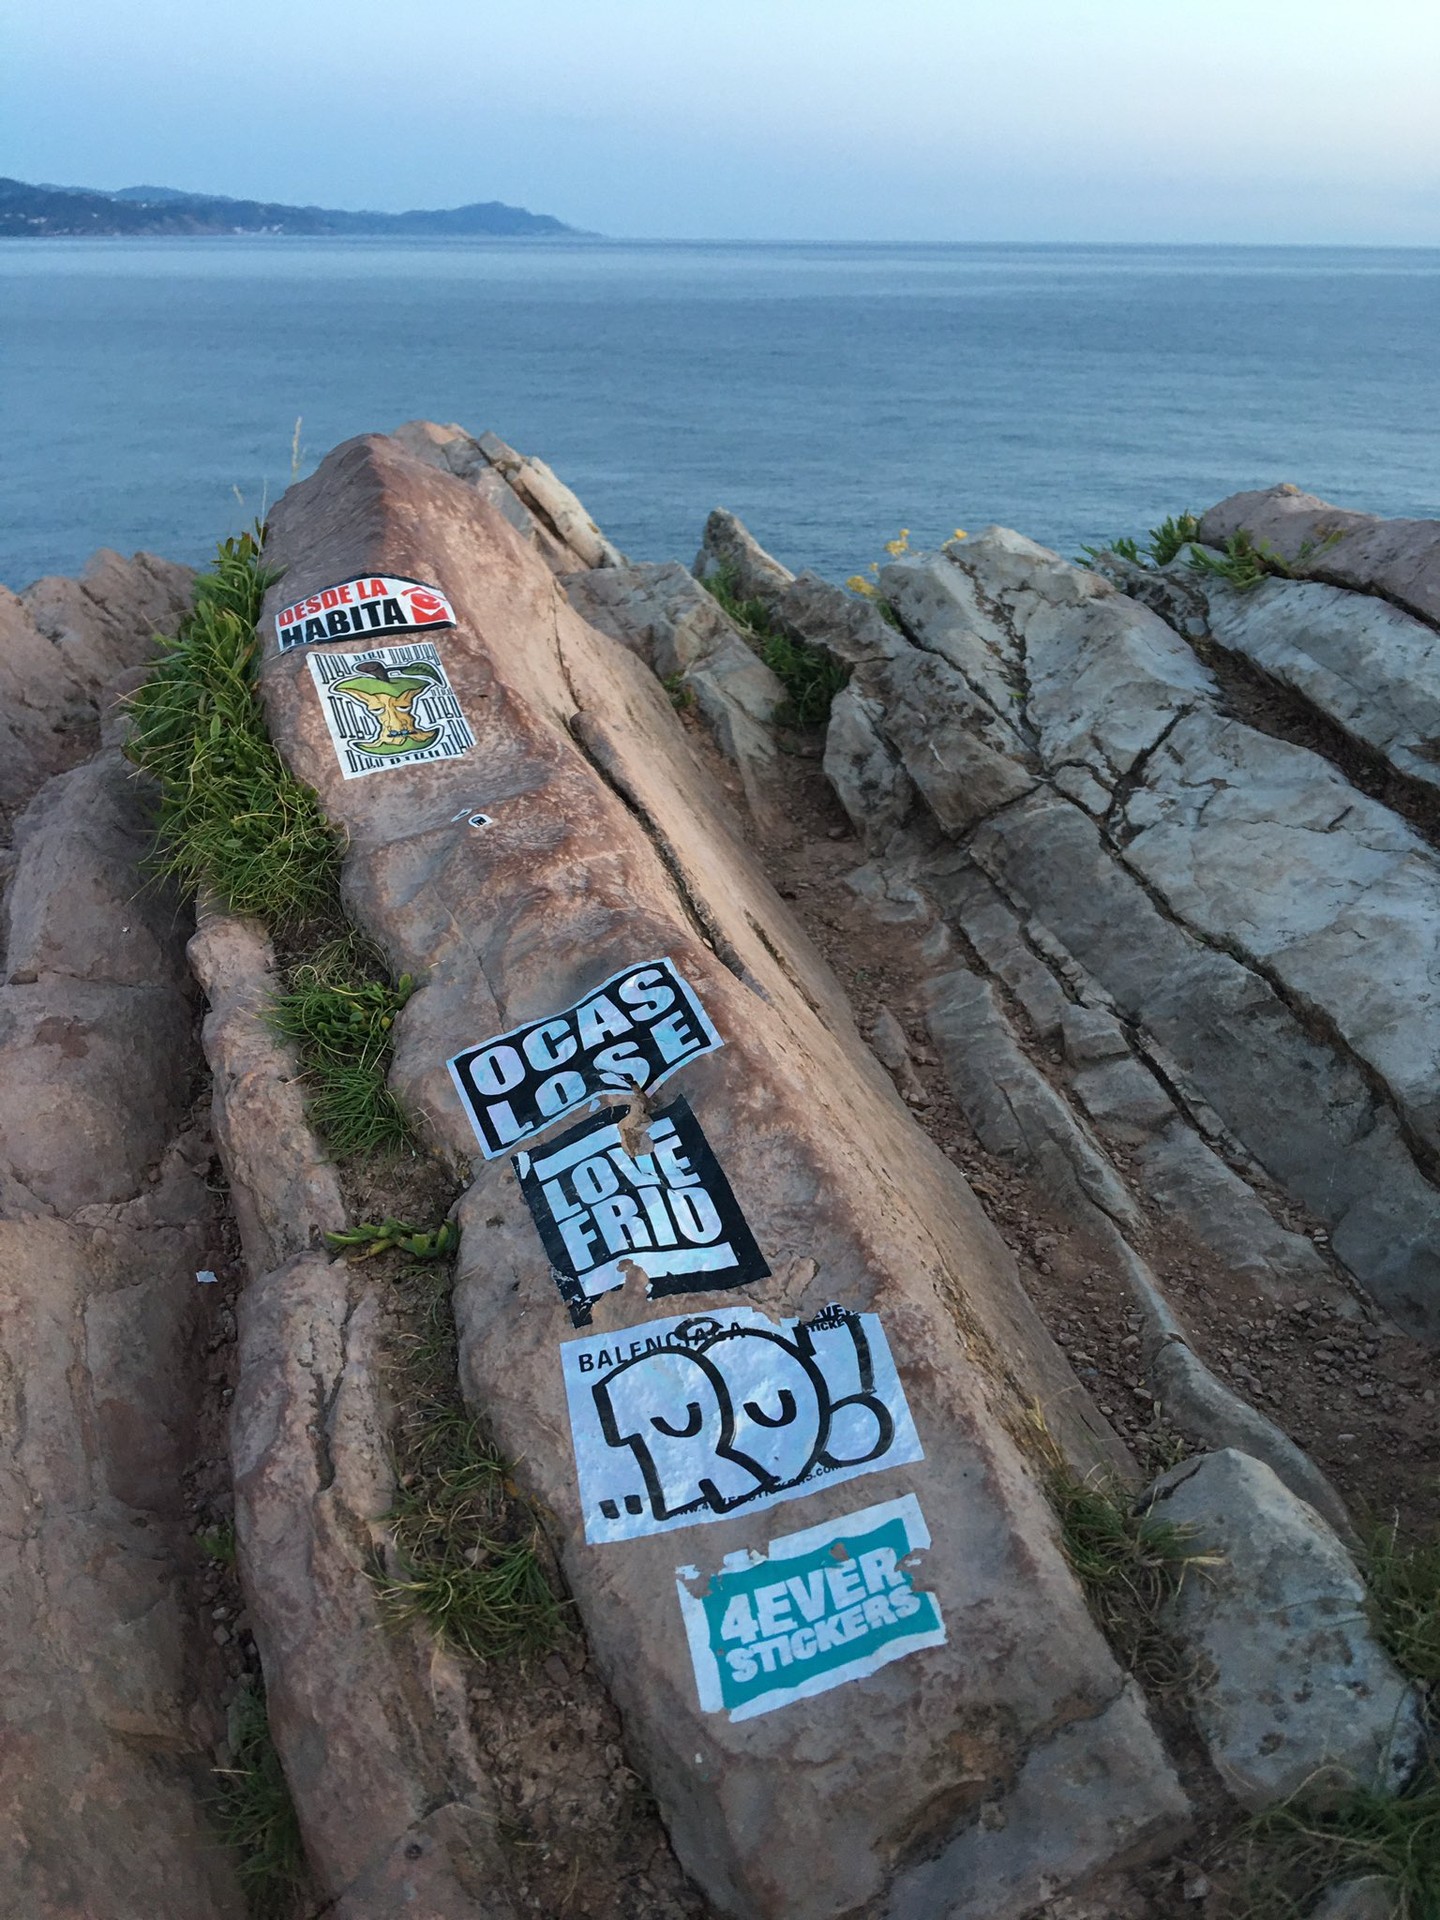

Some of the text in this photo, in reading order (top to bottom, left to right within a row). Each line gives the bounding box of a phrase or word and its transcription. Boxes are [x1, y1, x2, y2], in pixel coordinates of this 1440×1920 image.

[278, 579, 388, 627] DESDE LA
[281, 597, 408, 648] HABITA
[469, 969, 675, 1096] OCAS
[486, 1009, 700, 1145] LOSE
[541, 1138, 701, 1223] LOVE
[557, 1186, 723, 1271] FRIO
[720, 1547, 904, 1645] 4EVER
[726, 1585, 921, 1683] STICKERS
